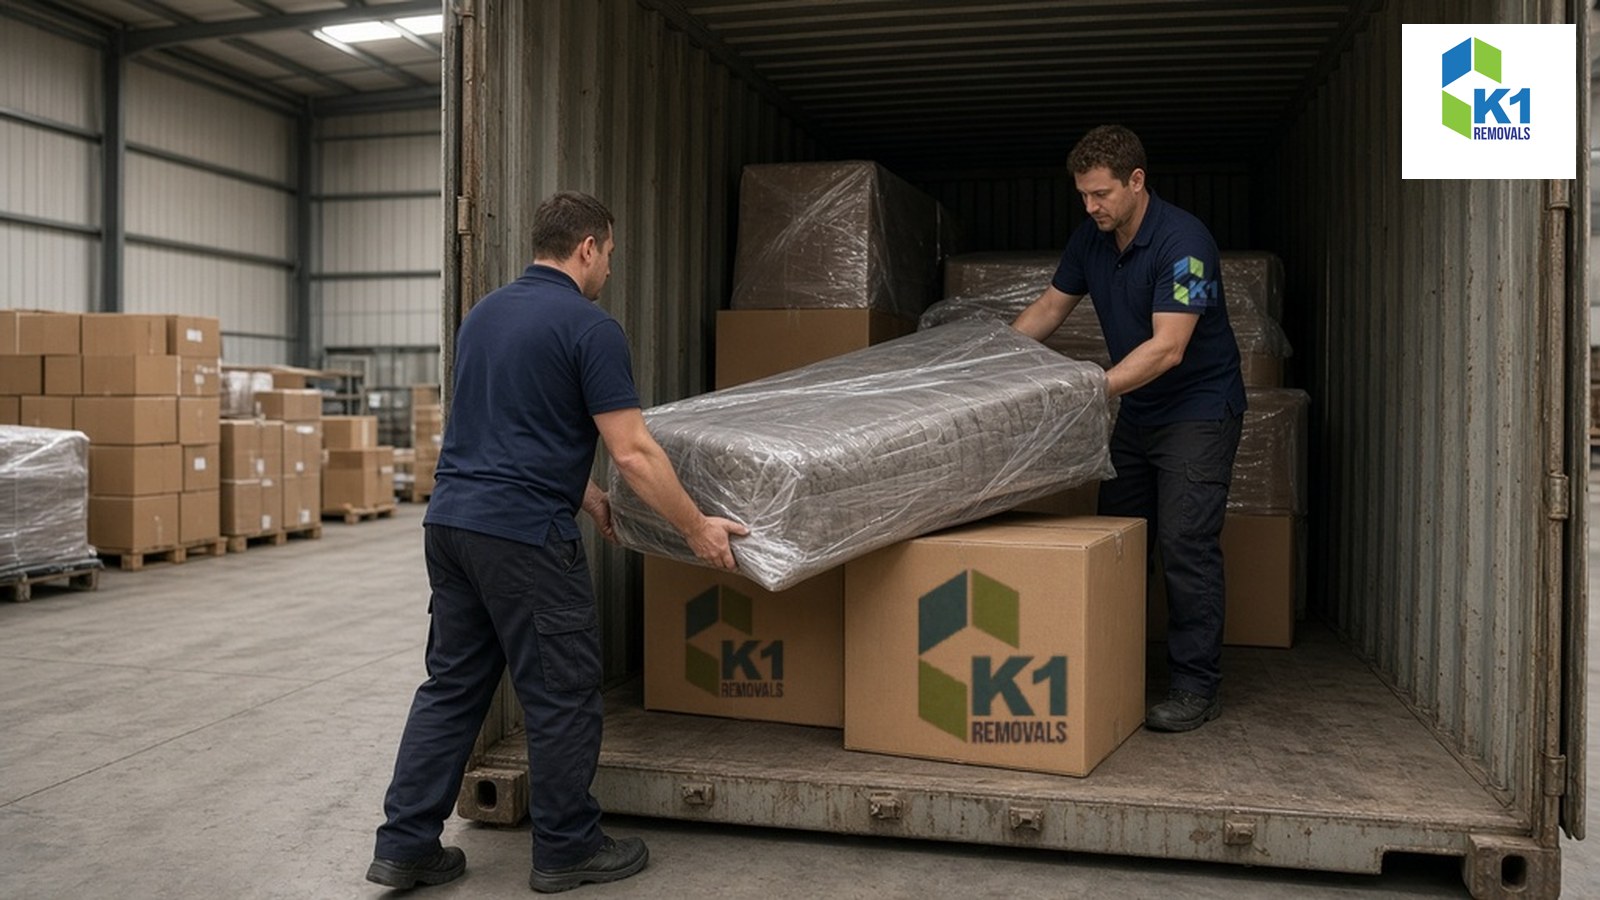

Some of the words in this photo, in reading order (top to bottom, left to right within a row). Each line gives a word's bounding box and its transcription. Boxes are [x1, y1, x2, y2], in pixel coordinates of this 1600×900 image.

[1189, 280, 1218, 299] K1
[721, 640, 784, 681] K1
[721, 683, 784, 698] REMOVALS
[971, 656, 1067, 716] K1
[971, 721, 1067, 743] REMOVALS
